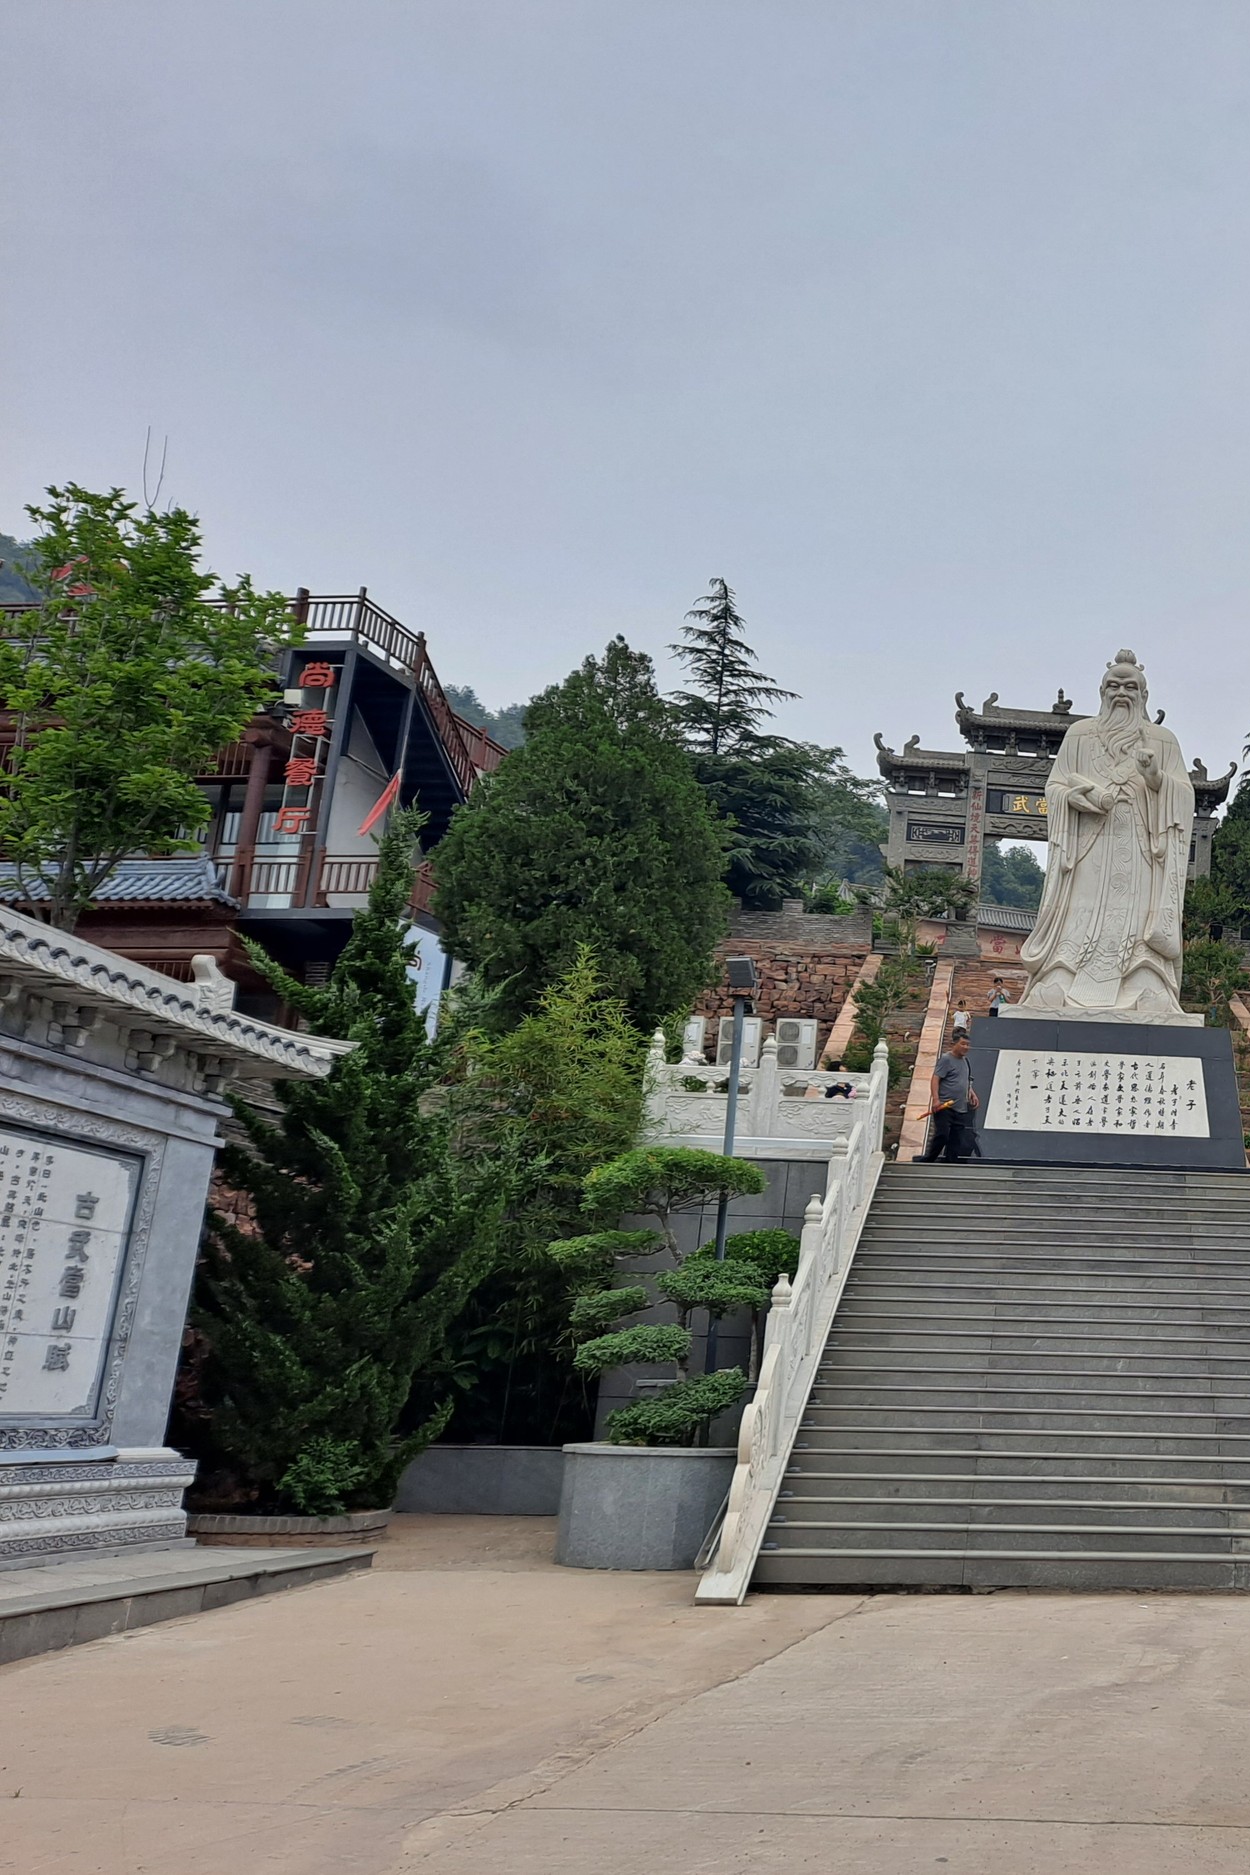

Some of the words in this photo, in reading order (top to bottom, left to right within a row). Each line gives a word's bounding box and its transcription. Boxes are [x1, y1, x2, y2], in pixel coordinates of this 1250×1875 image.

[272, 662, 336, 834] 尚德餐厅
[1185, 1079, 1197, 1111] 老子
